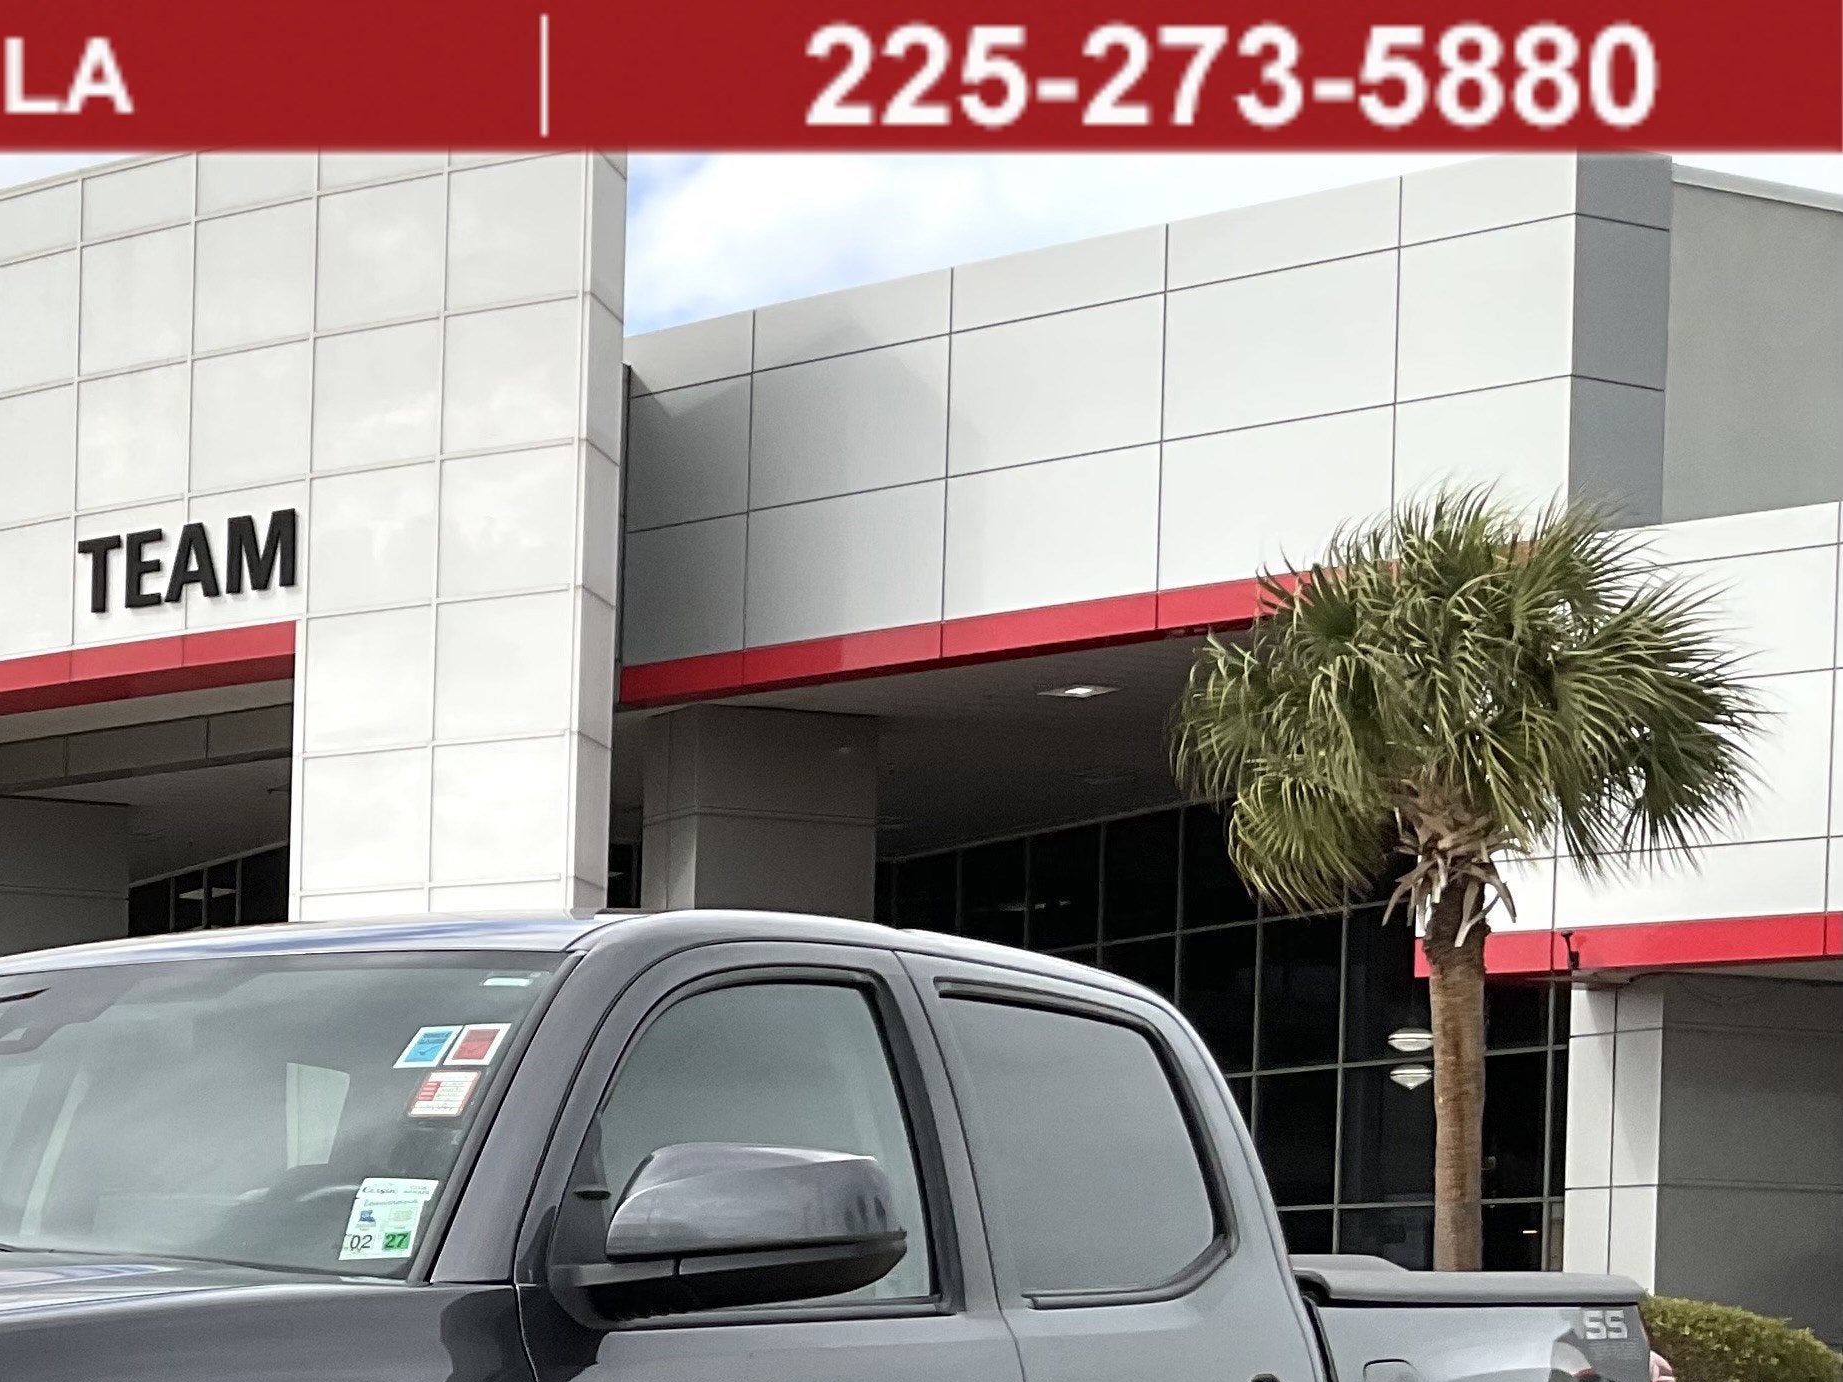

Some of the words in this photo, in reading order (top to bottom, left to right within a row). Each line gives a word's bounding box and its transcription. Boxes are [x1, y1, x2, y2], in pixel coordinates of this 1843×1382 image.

[77, 507, 298, 615] TEAM
[349, 1234, 373, 1249] 02
[384, 1233, 409, 1249] 27
